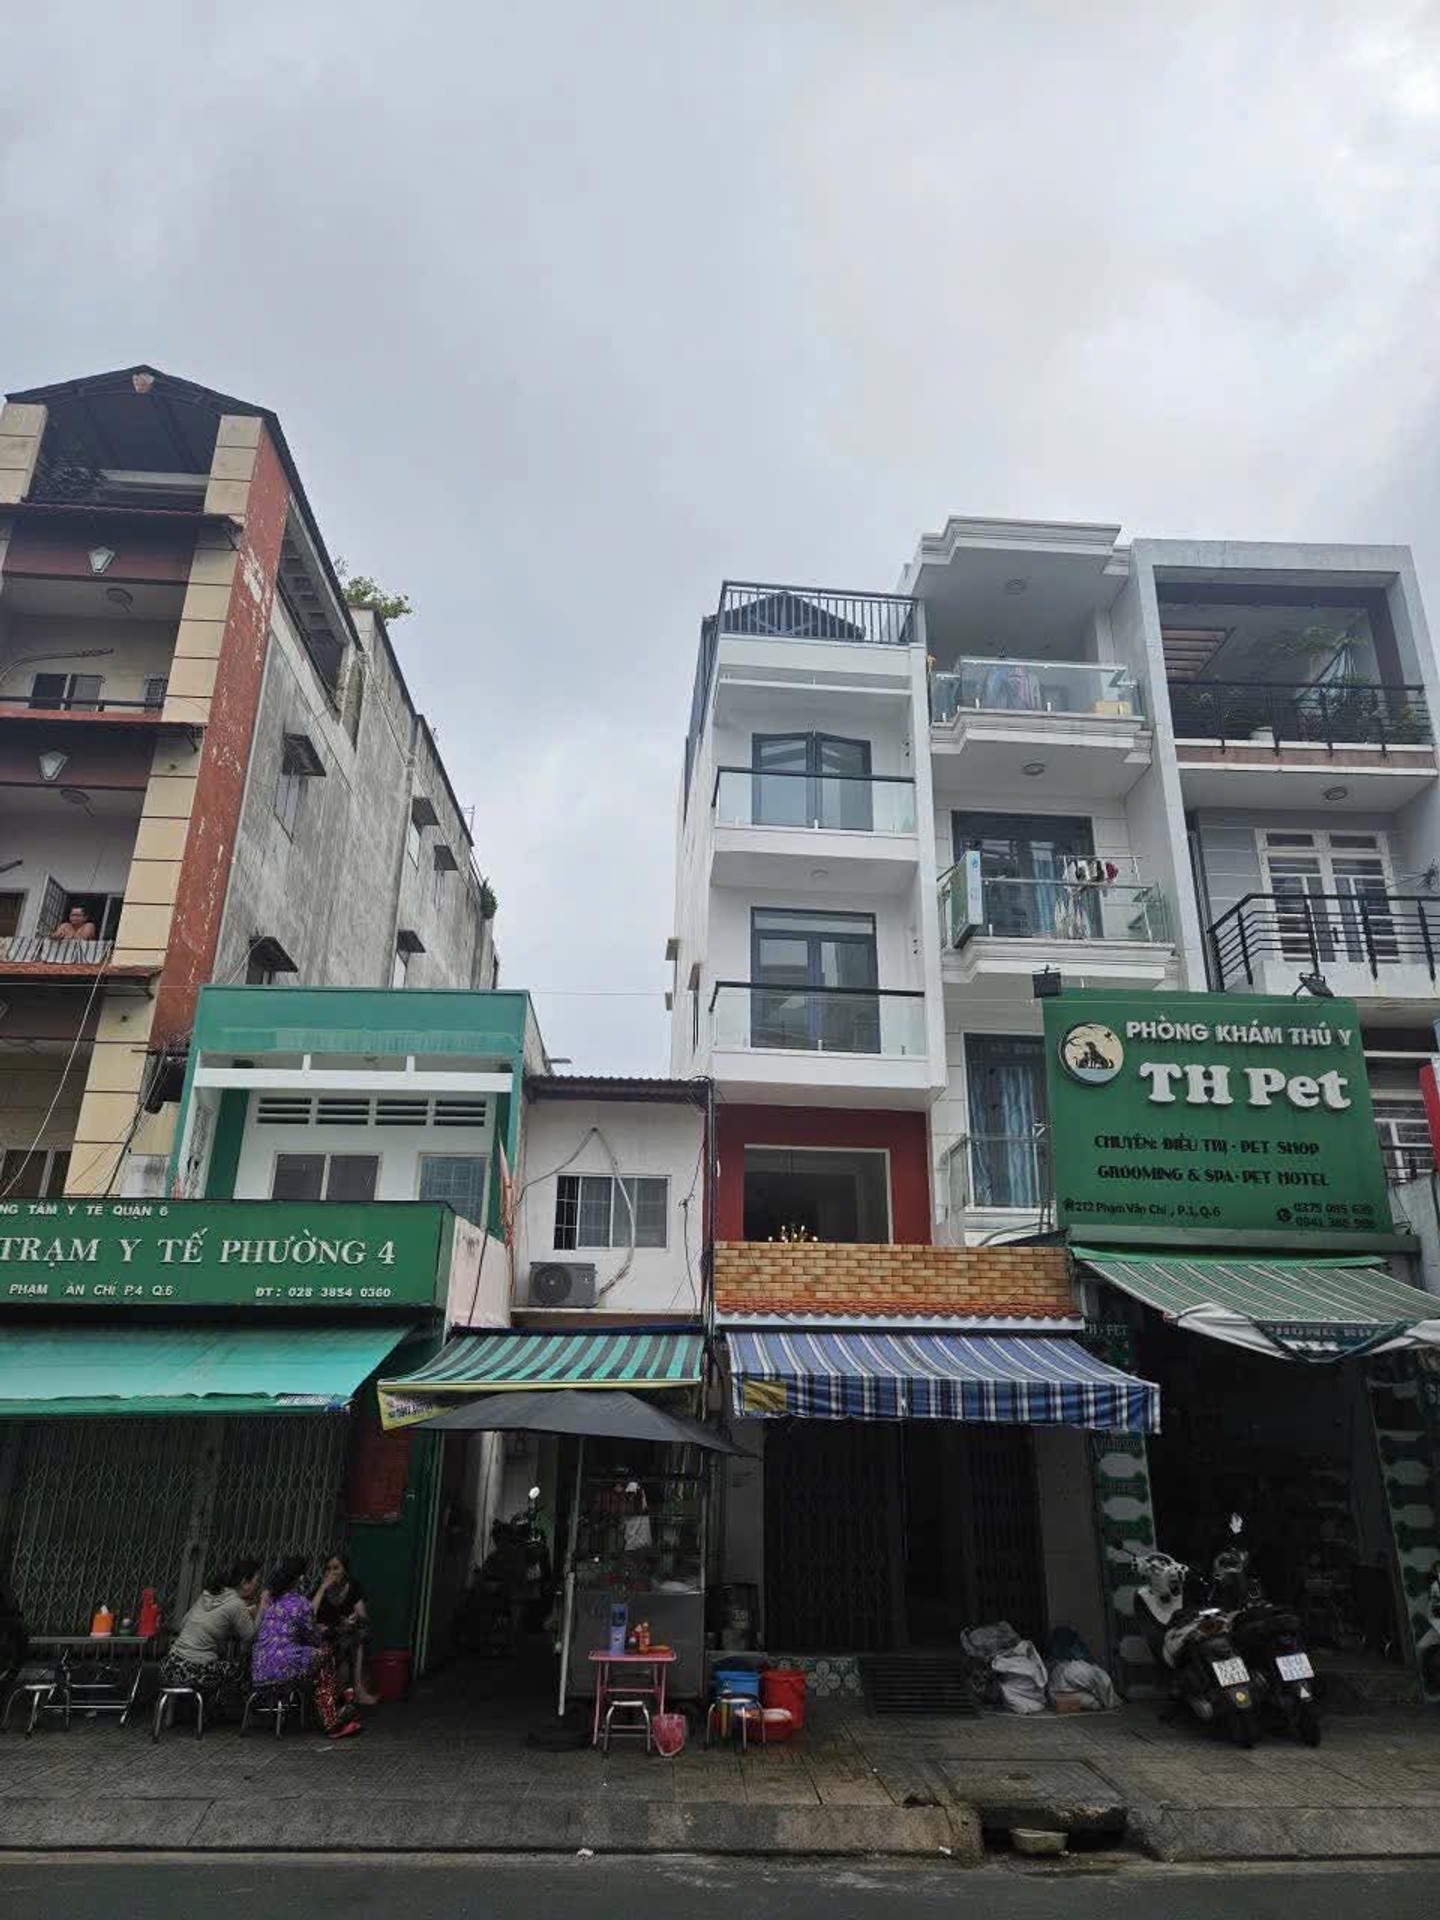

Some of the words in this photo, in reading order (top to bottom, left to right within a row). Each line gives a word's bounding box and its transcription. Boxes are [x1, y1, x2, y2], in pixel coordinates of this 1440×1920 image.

[1126, 1015, 1209, 1041] PHÒNG
[1215, 1019, 1283, 1044] KHÁM
[1288, 1021, 1332, 1046] THÚ
[1338, 1029, 1352, 1046] Y
[1139, 1062, 1234, 1105] TH
[1244, 1067, 1352, 1109] Pet
[1241, 1140, 1270, 1154] PET
[1277, 1141, 1320, 1155] SHOP
[1098, 1165, 1183, 1182] GROOMING
[1187, 1168, 1200, 1182] &
[68, 1205, 77, 1215] Y
[160, 1206, 169, 1216] 6
[0, 1237, 100, 1267] TRẠM
[118, 1238, 142, 1263] Y
[157, 1227, 208, 1264] TẾ
[218, 1229, 367, 1265] PHƯỜNG
[378, 1240, 395, 1265] 4
[287, 1286, 313, 1298] 028
[320, 1286, 353, 1298] 3854
[359, 1286, 392, 1298] 0360
